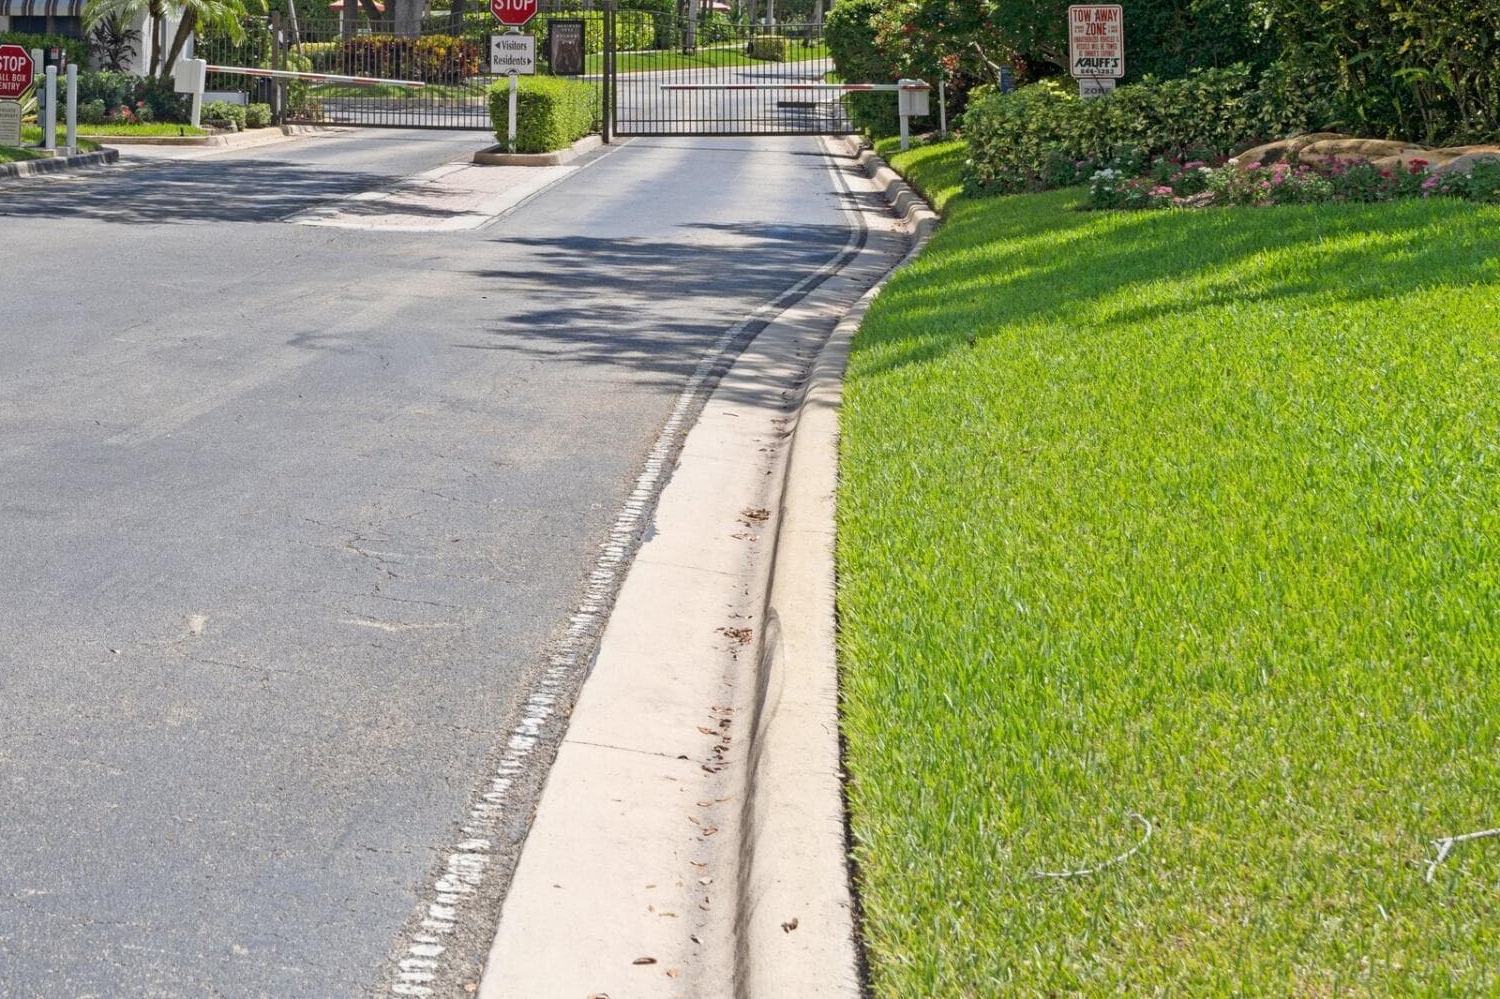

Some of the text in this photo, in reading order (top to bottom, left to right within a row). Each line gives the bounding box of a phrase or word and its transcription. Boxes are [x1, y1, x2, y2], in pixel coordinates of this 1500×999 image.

[1073, 9, 1118, 22] TOW AWAY
[1085, 23, 1107, 36] ZONE
[501, 40, 528, 51] Visitors
[493, 54, 527, 65] Residents
[1075, 57, 1120, 67] KAUFF'S
[11, 73, 27, 82] BOX
